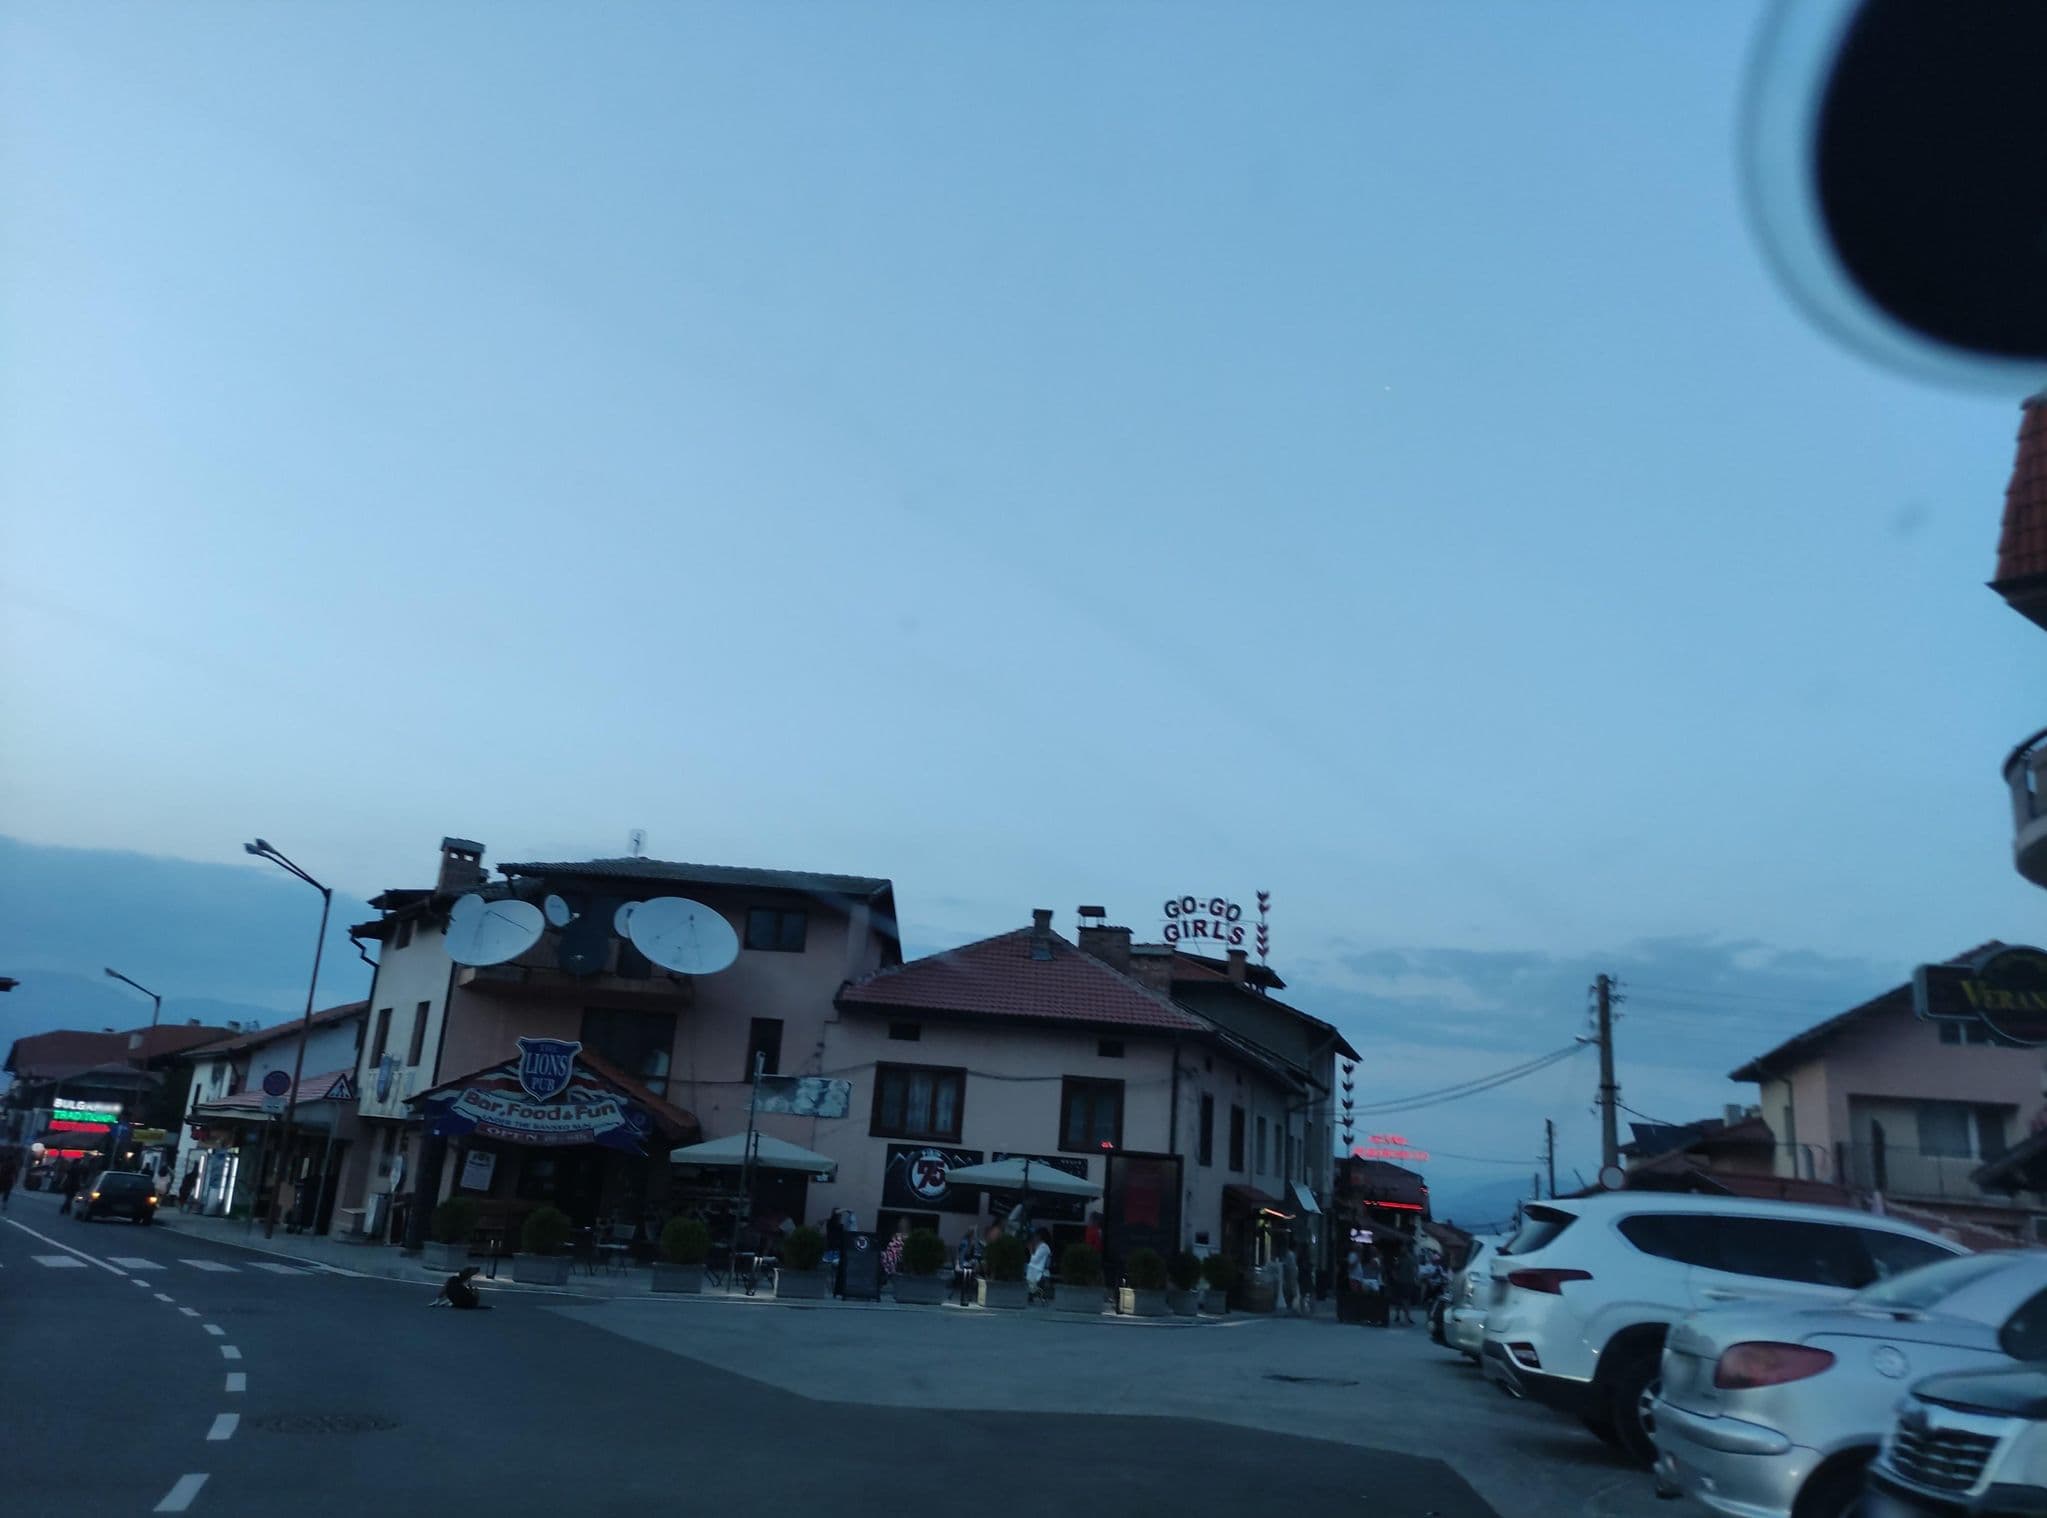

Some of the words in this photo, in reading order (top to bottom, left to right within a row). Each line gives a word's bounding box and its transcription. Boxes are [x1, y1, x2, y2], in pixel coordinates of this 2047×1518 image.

[1164, 896, 1241, 921] GO-GO
[1164, 920, 1244, 944] GIRLS
[526, 1053, 568, 1077] LIONS
[531, 1077, 555, 1091] PUB
[506, 1103, 560, 1120] Food
[575, 1103, 616, 1120] Fun
